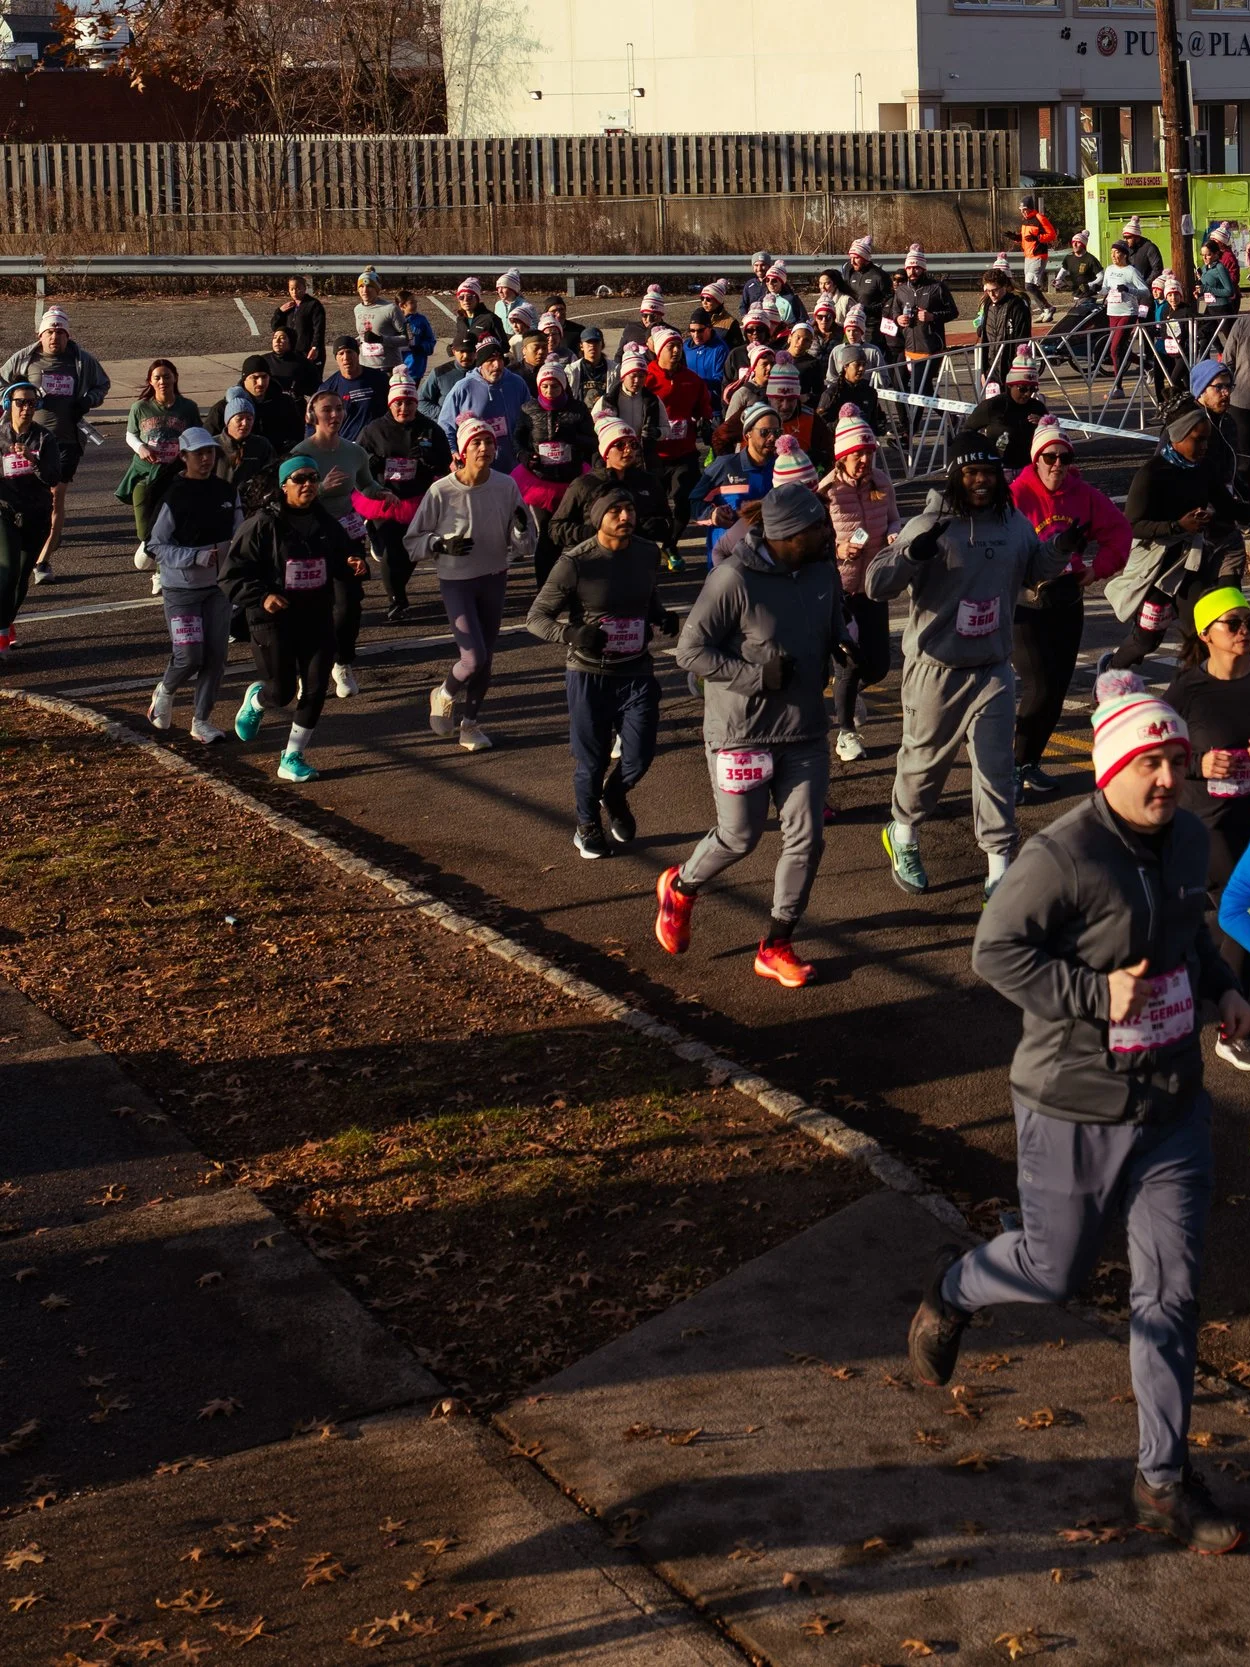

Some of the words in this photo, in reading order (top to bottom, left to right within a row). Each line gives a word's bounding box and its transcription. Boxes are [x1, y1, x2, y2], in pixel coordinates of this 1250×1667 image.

[1125, 177, 1142, 186] CLOTHES
[1148, 177, 1161, 185] SHOES
[957, 452, 983, 464] NIKE
[294, 569, 321, 580] 3362
[726, 768, 762, 780] 3598
